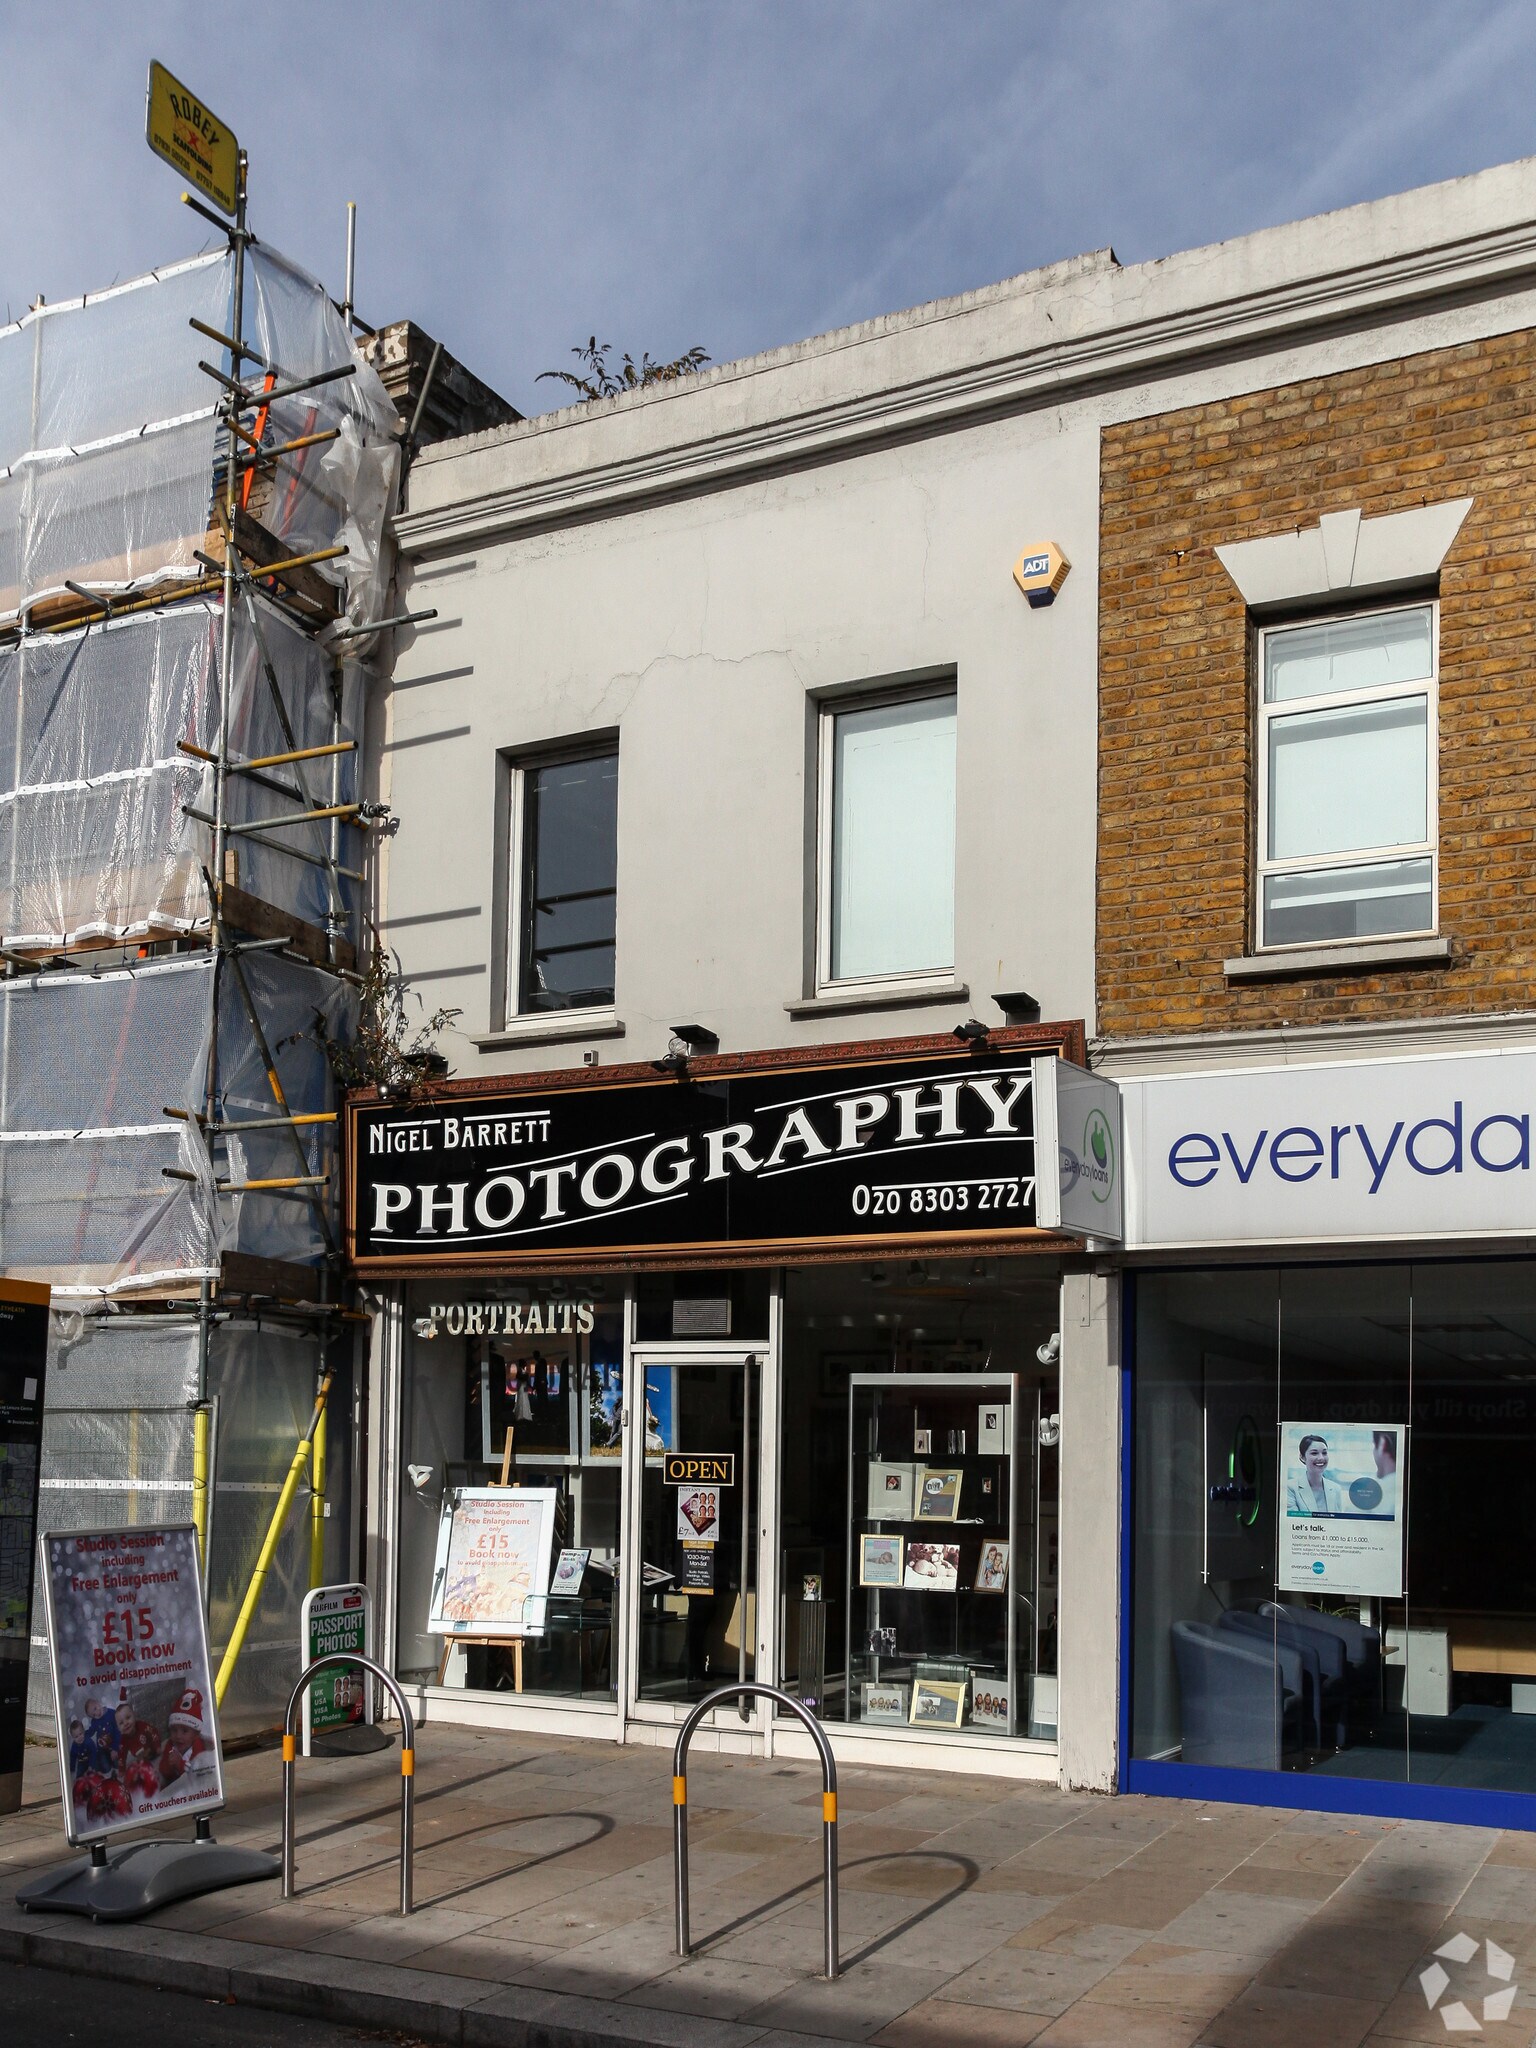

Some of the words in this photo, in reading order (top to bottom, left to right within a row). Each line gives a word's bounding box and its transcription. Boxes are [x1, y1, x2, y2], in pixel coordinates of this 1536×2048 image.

[170, 93, 220, 146] ROBEY
[173, 133, 213, 174] SCAFFOLDING
[1024, 559, 1048, 574] ADT
[371, 1076, 1032, 1234] PHOTOGRAPHY
[852, 1184, 901, 1216] 020
[909, 1186, 968, 1212] 8303
[978, 1177, 1036, 1210] 2727
[429, 1300, 595, 1336] PORTRAITS
[669, 1460, 728, 1479] OPEN
[471, 1500, 495, 1508] Studio
[482, 1518, 529, 1526] Enlargement
[76, 1537, 117, 1552] Studio
[120, 1535, 165, 1549] Session
[477, 1534, 509, 1549] £15
[101, 1554, 145, 1567] including
[469, 1550, 494, 1558] Book
[71, 1577, 99, 1592] Free
[103, 1569, 179, 1589] Enlargement
[117, 1592, 137, 1605] only
[310, 1602, 338, 1613] FUJIFILM
[102, 1607, 154, 1644] £15
[311, 1612, 364, 1637] PASSPORT
[318, 1632, 358, 1654] PHOTOS
[94, 1644, 136, 1667] Book
[141, 1643, 175, 1660] now
[77, 1676, 88, 1687] to
[89, 1670, 116, 1685] avoid
[120, 1660, 193, 1681] disappointment
[314, 1689, 324, 1697] UK
[314, 1697, 327, 1706] USA
[314, 1706, 328, 1715] VISA
[321, 1713, 341, 1722] Photos
[138, 1803, 153, 1814] Gift
[155, 1796, 187, 1810] vouchers
[188, 1787, 219, 1802] available
